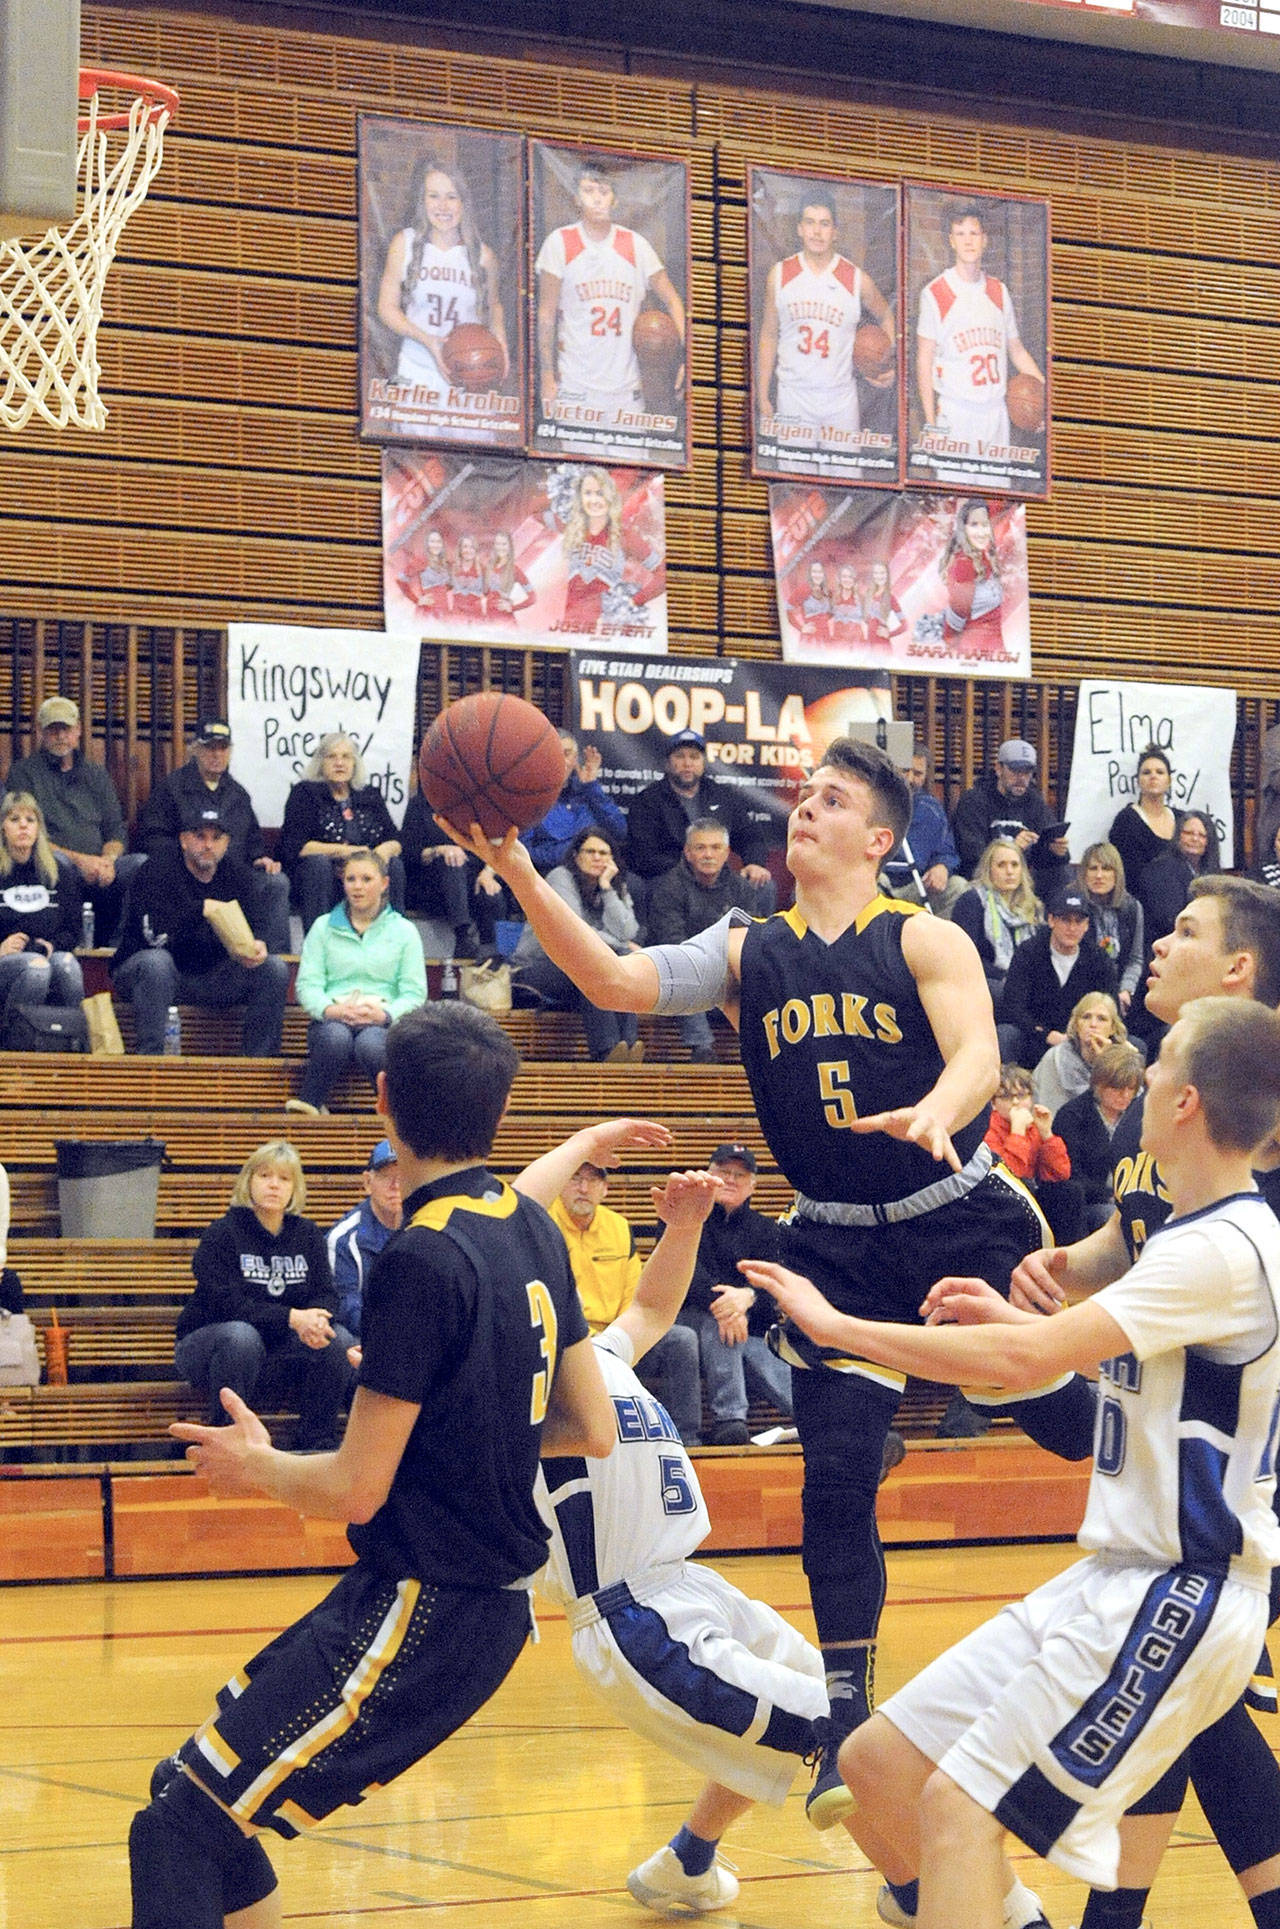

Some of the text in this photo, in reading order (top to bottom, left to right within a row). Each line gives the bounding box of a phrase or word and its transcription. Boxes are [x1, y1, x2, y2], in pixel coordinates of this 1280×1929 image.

[1223, 8, 1254, 28] 2004
[420, 266, 470, 287] OQUIA
[427, 294, 461, 329] 34
[591, 306, 622, 336] 24
[797, 325, 830, 359] 34
[970, 353, 1001, 386] 20
[368, 378, 521, 415] Karlie Krohn
[542, 398, 678, 432] Victor James
[759, 415, 893, 448] Bryan Morales
[911, 431, 1041, 464] Jadan Varner
[241, 643, 393, 723] Kingsway
[578, 659, 734, 684] FIVE STAR DEALERSHIPS
[578, 679, 813, 743] HOOP-LA
[1089, 690, 1175, 755] Elma
[705, 742, 814, 768] FOR KIDS
[762, 992, 903, 1060] FORKS
[817, 1060, 859, 1129] 5
[241, 1253, 309, 1272] ELMA
[526, 1279, 558, 1426] 3
[659, 1455, 698, 1516] 5
[1070, 1574, 1209, 1767] EAGLES
